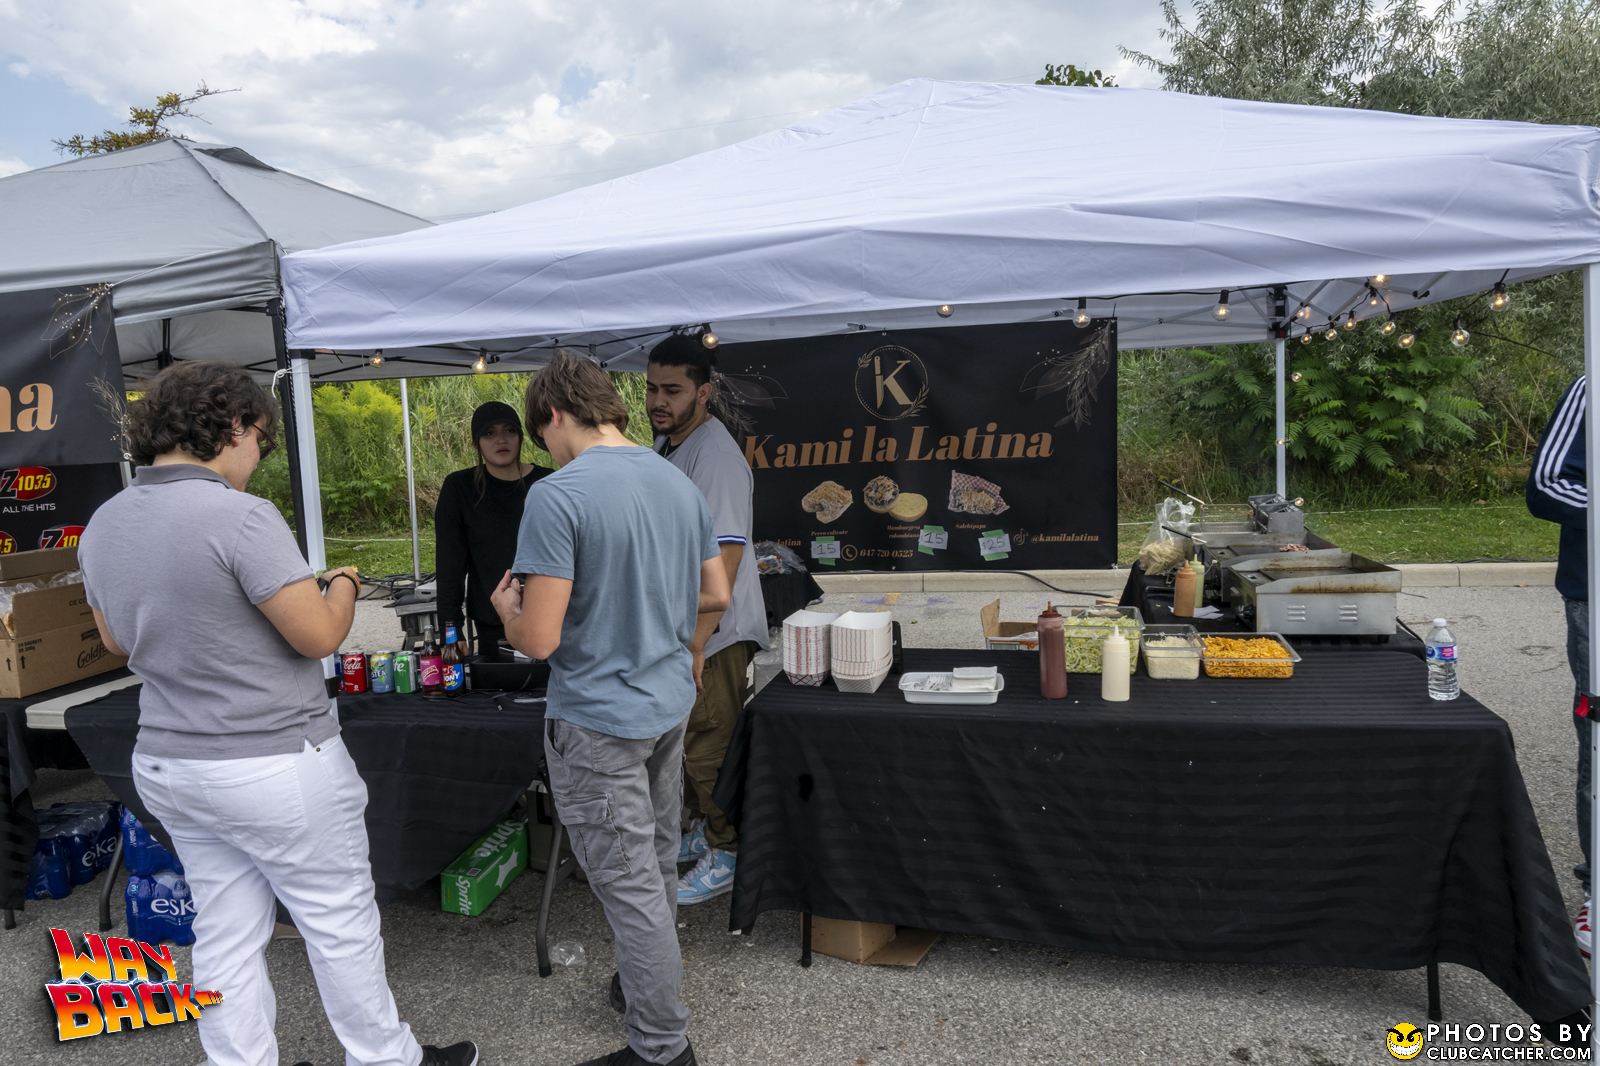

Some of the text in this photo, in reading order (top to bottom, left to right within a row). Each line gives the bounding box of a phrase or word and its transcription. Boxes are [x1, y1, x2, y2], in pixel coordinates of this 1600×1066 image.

[744, 421, 1054, 469] Kami la Latina
[2, 503, 57, 514] ALL THE HITS
[1031, 533, 1099, 544] @kamilalatina
[474, 818, 529, 858] Sprite
[456, 875, 472, 916] Sprite
